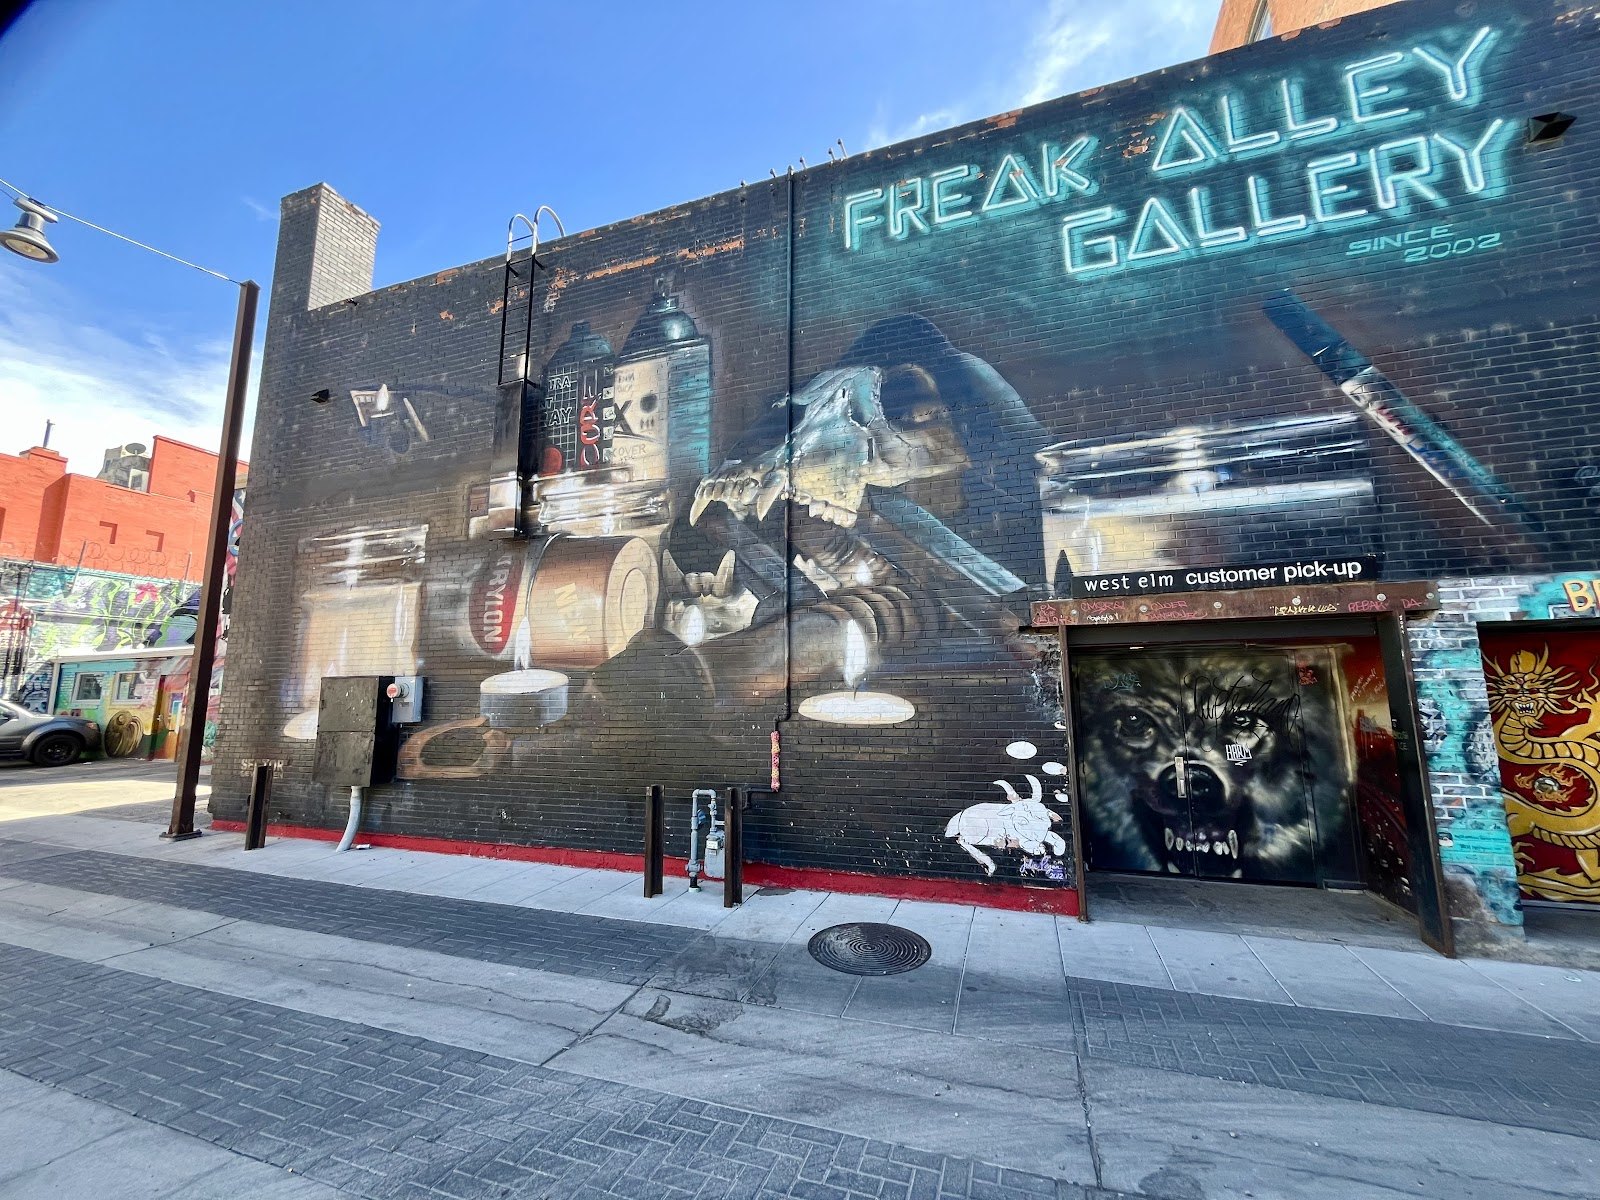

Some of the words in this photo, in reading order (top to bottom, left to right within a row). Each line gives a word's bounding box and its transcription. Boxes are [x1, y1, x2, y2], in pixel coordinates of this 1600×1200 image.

[843, 135, 1098, 252] FREAK
[1151, 23, 1500, 176] ALLEY
[1062, 116, 1514, 276] GALLERY
[1346, 223, 1454, 256] SINCE
[1404, 232, 1503, 262] 2002
[1084, 574, 1130, 592] west
[1138, 573, 1174, 588] elm
[1185, 567, 1278, 585] customer
[1283, 560, 1362, 583] pick-up
[241, 758, 284, 771] SETOR
